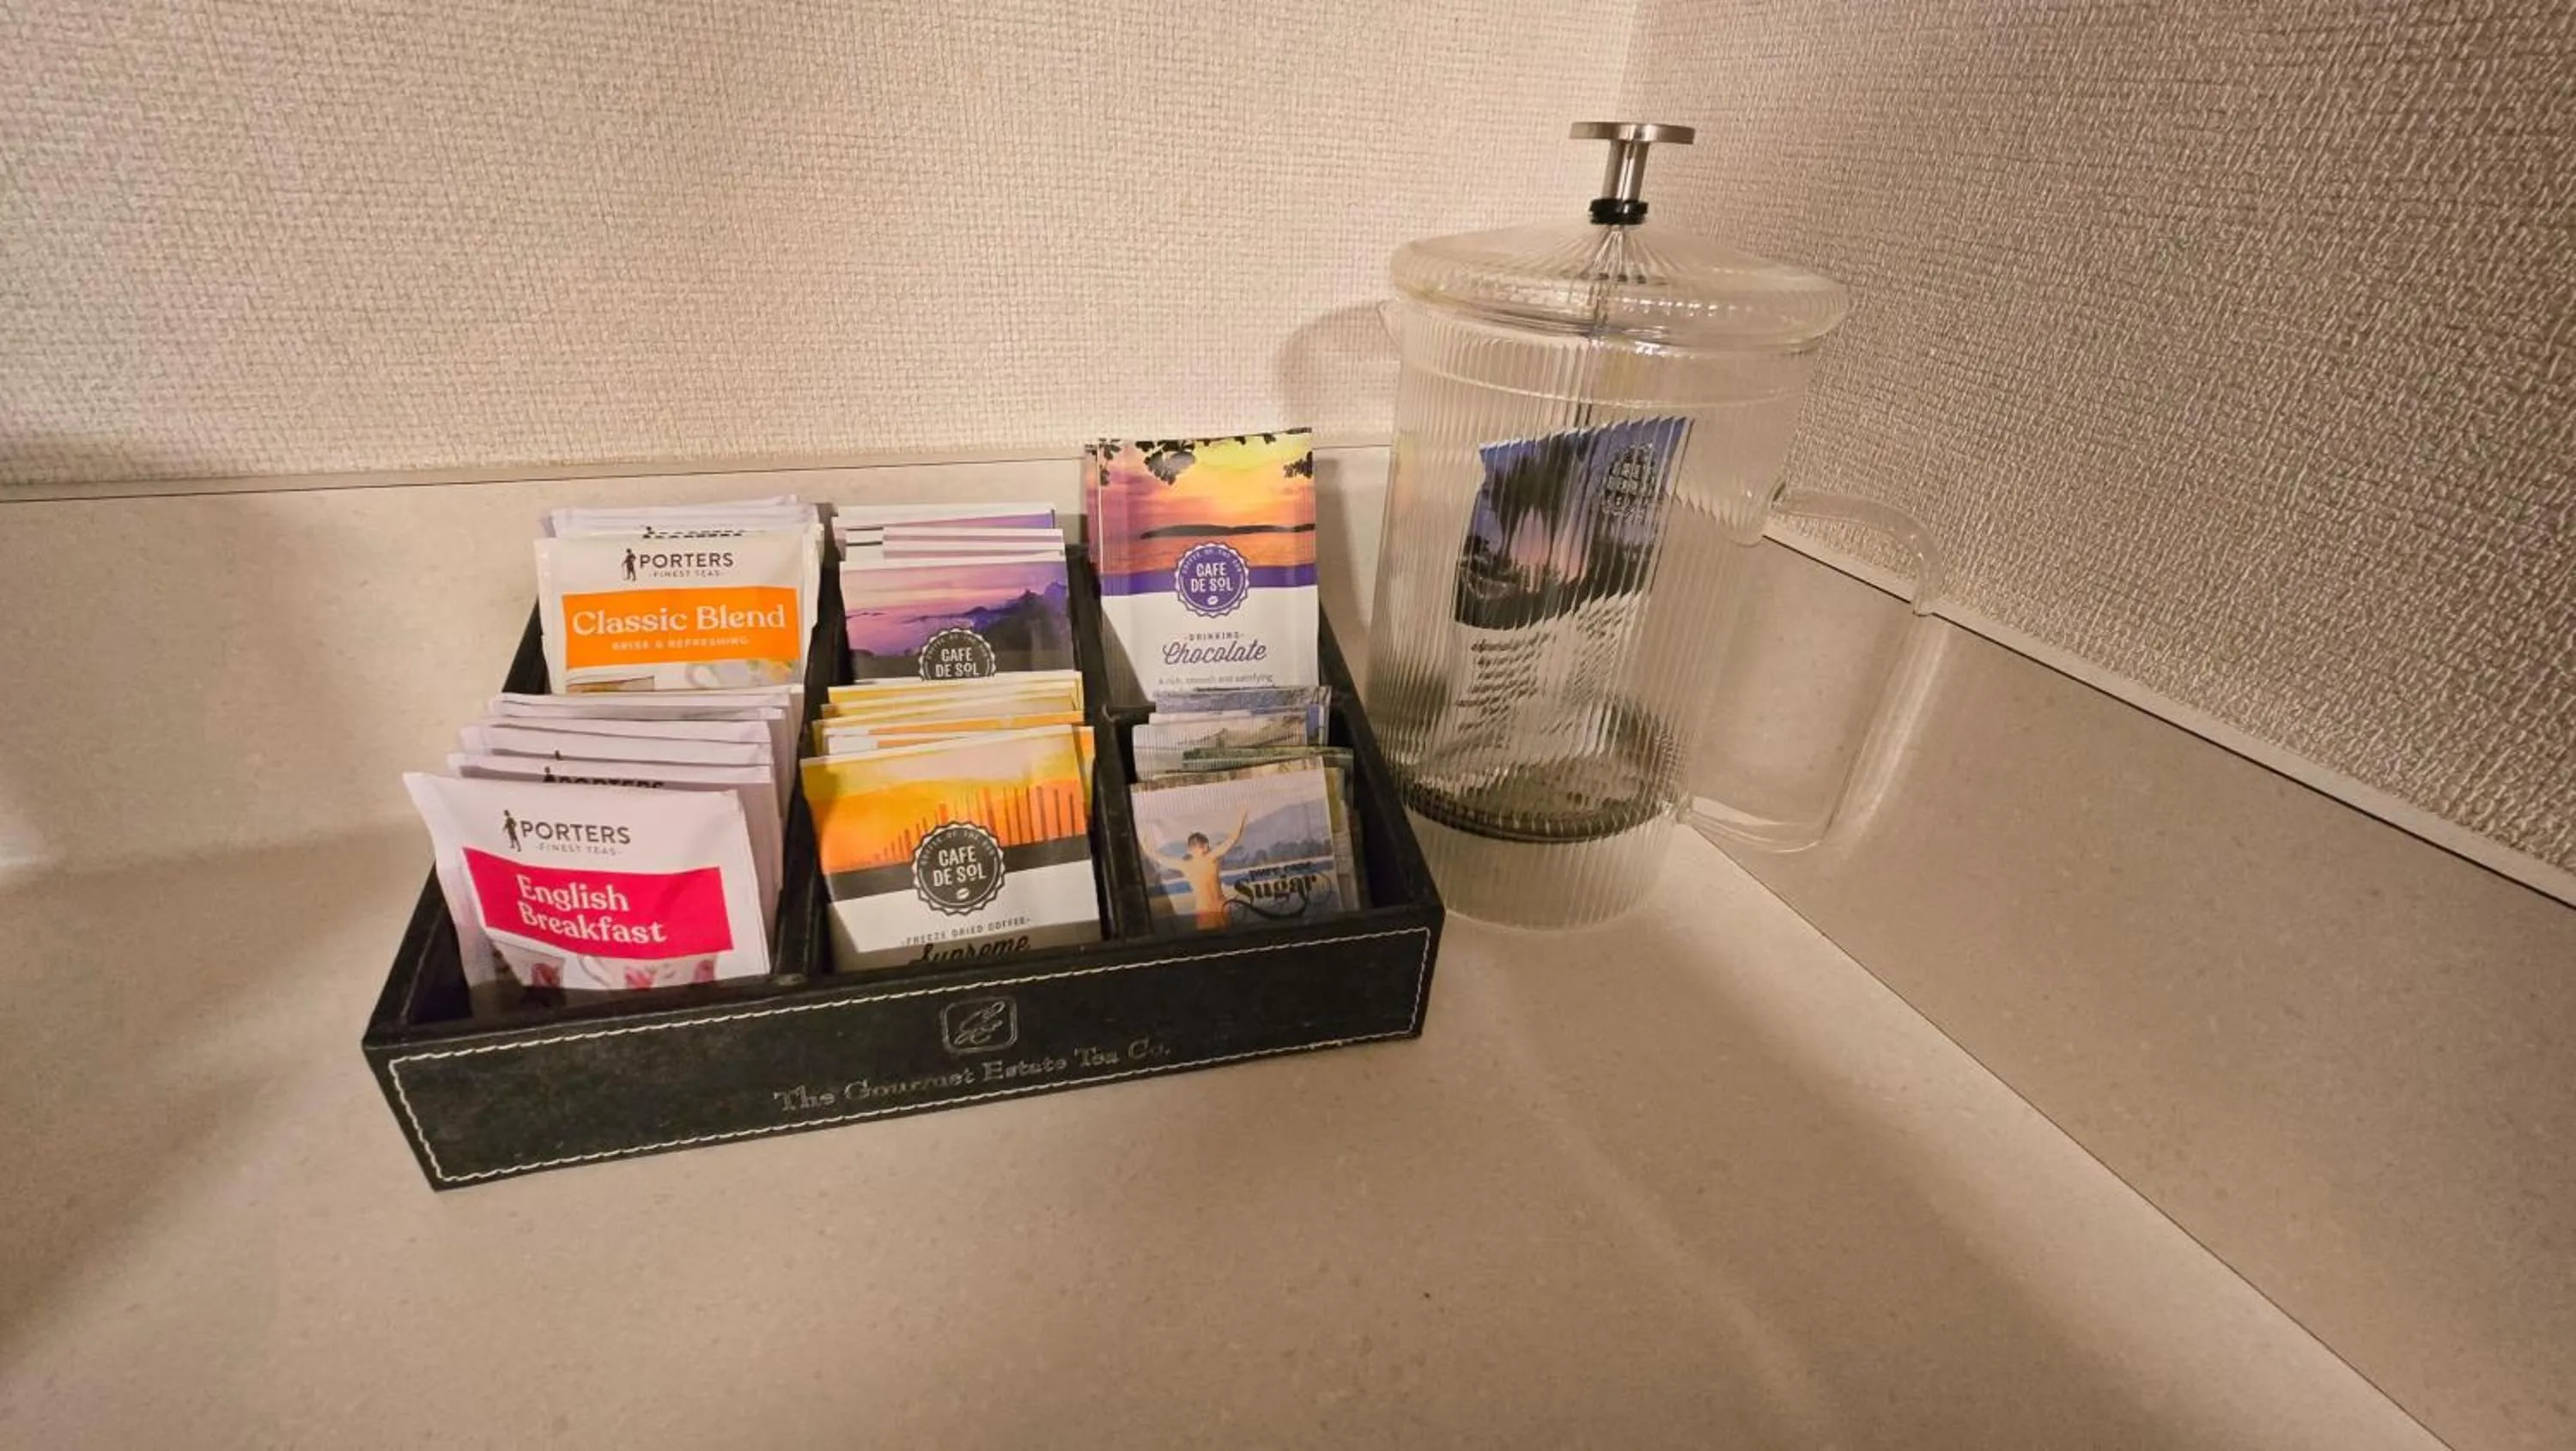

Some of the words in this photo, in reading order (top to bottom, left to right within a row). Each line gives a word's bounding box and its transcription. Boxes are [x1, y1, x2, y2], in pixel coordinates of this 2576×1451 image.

[640, 552, 734, 568] PORTERS
[1196, 562, 1227, 577] CAFE
[1191, 578, 1206, 592] DE
[1209, 576, 1234, 592] SOL
[573, 607, 688, 637] Classic
[696, 604, 786, 631] Blend
[940, 647, 973, 662] CAFE
[1162, 638, 1267, 665] Chocolate
[935, 664, 952, 677] DE
[955, 662, 980, 677] SOL
[520, 820, 631, 845] PORTERS
[938, 845, 977, 867] CAFE
[933, 867, 953, 887] DE
[956, 862, 987, 883] SOL
[515, 873, 630, 914] English
[1234, 873, 1317, 907] Sugar
[517, 900, 669, 944] Breakfast
[774, 1084, 835, 1112] The
[844, 1068, 975, 1101] Gourmet
[981, 1058, 1067, 1084] Estate
[1073, 1046, 1121, 1067] Tea
[1127, 1037, 1173, 1059] Co.
